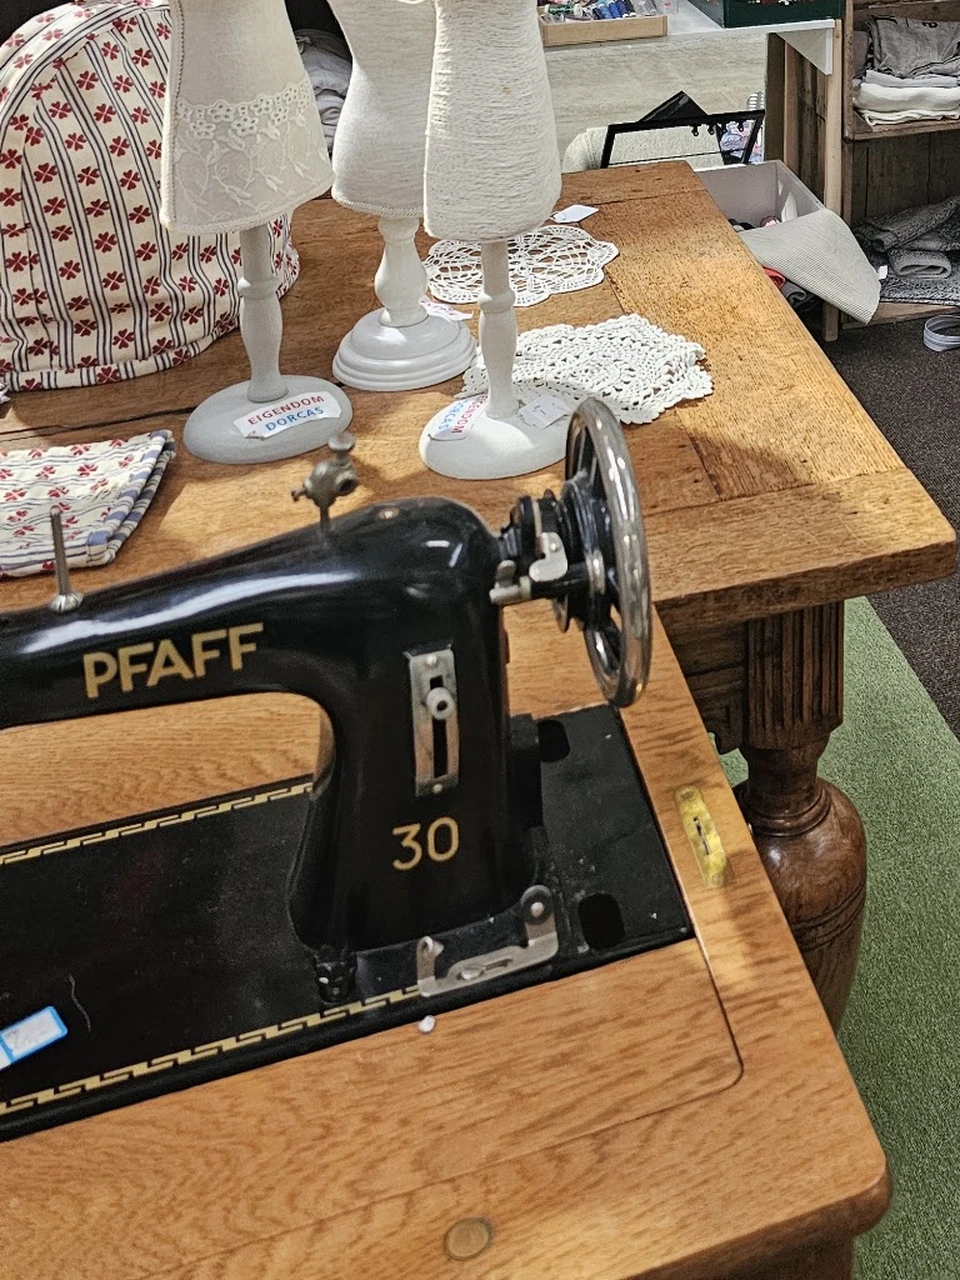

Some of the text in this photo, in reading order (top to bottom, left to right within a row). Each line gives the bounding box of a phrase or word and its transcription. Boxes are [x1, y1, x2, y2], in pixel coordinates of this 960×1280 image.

[247, 395, 326, 426] EIGENDOM
[265, 406, 325, 431] DORCAS
[83, 622, 264, 699] PFAFF
[391, 816, 460, 871] 30
